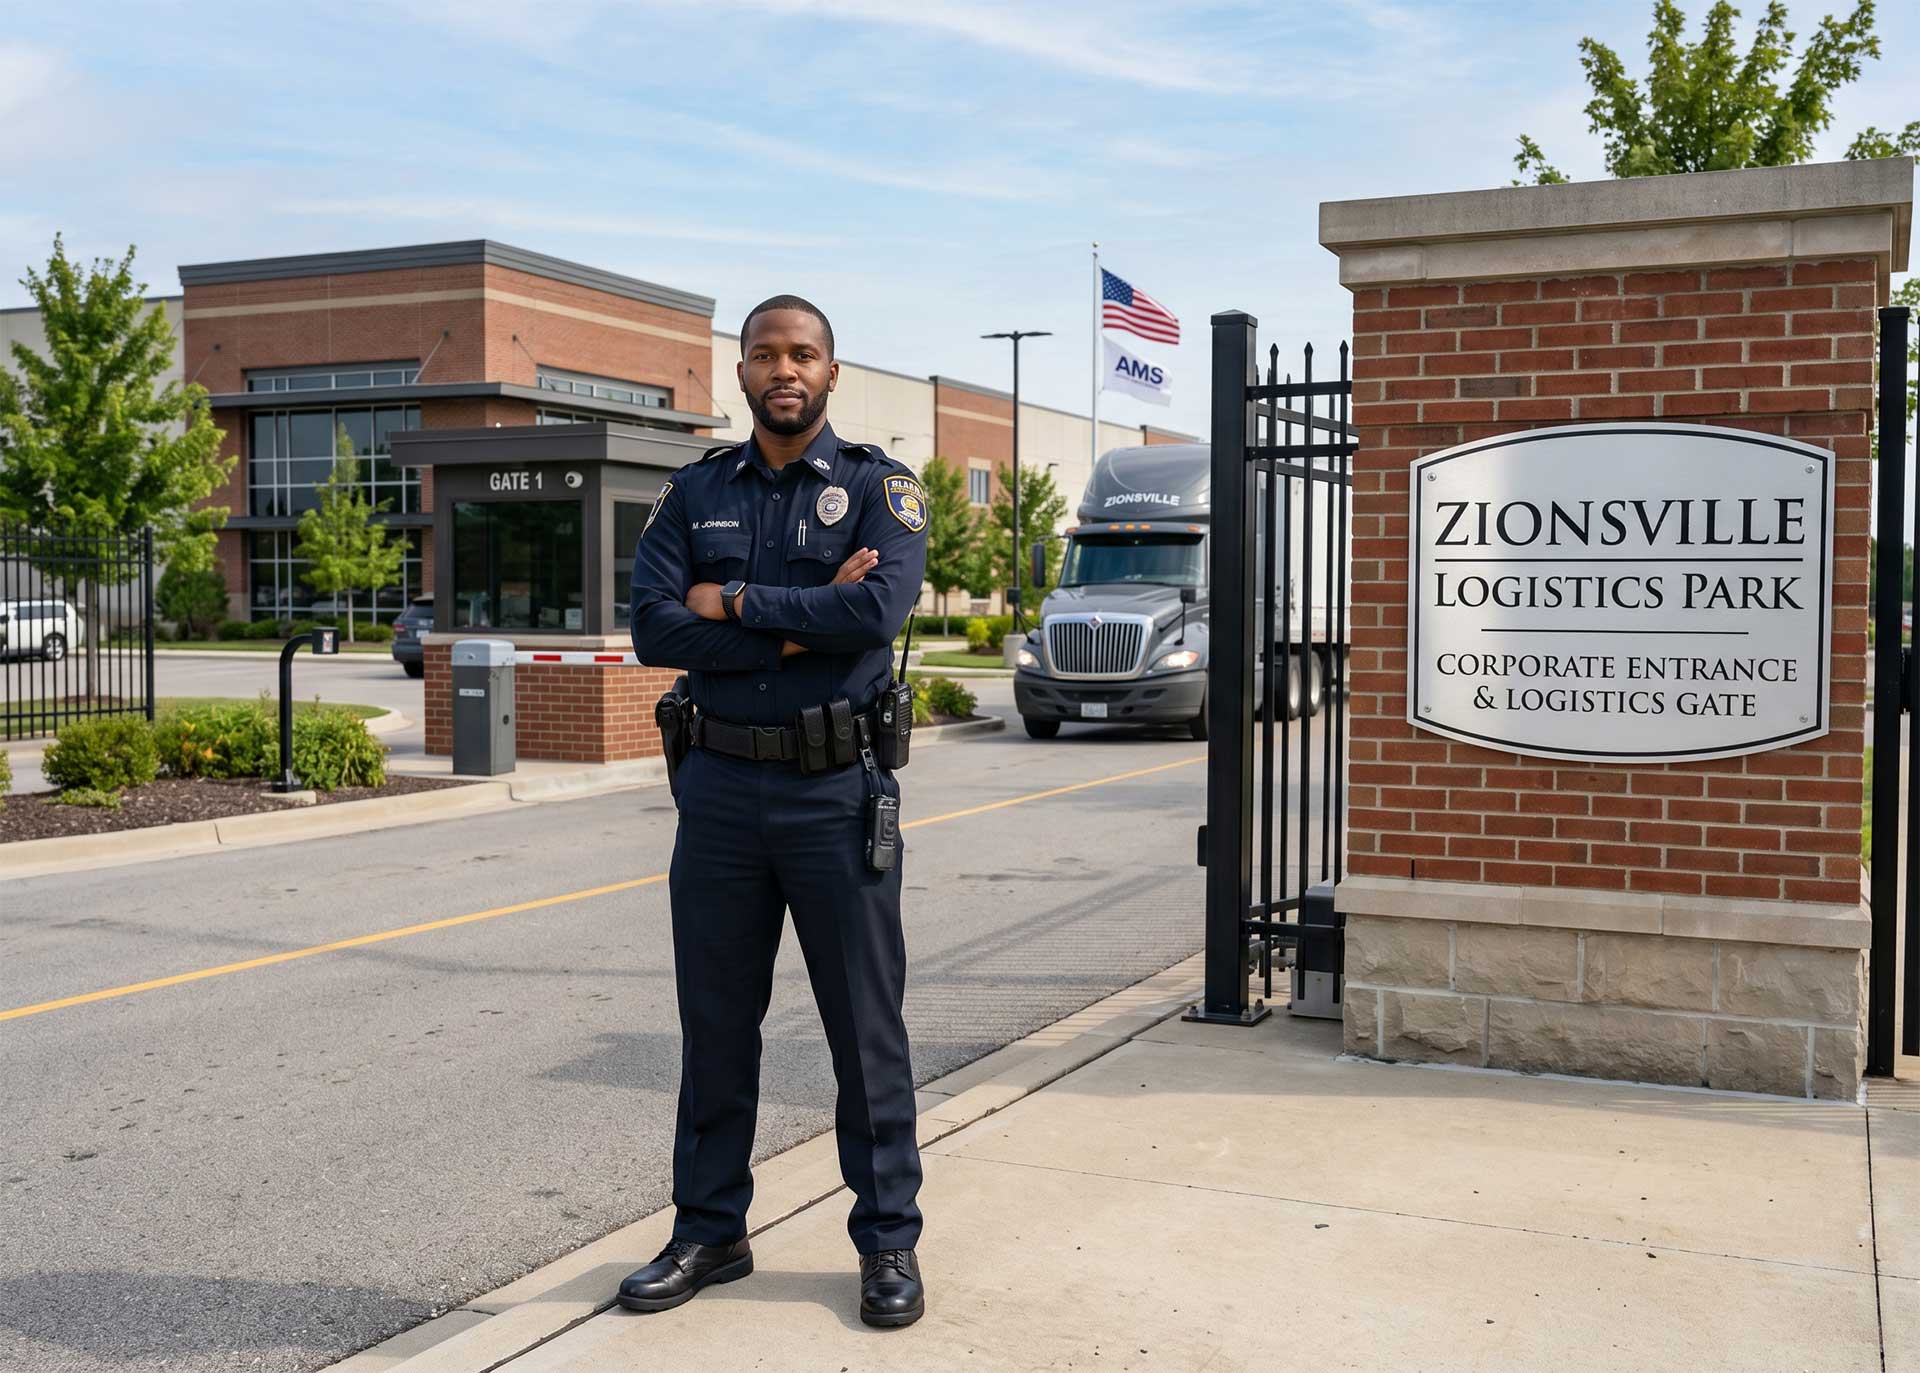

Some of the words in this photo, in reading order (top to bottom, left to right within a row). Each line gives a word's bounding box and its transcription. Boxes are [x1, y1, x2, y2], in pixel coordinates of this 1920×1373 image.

[1115, 355, 1164, 385] AMS
[489, 471, 530, 491] GATE
[535, 471, 543, 490] 1
[1103, 492, 1181, 508] ZIONSVILLE
[701, 520, 740, 529] JOHNSON
[1434, 497, 1806, 547] ZIONSVILLE
[1436, 653, 1616, 679] CORPORATE
[1626, 656, 1798, 682] ENTRANCE
[1473, 685, 1496, 710] &
[1506, 688, 1666, 715] LOGISTICS
[1676, 692, 1757, 717] GATE
